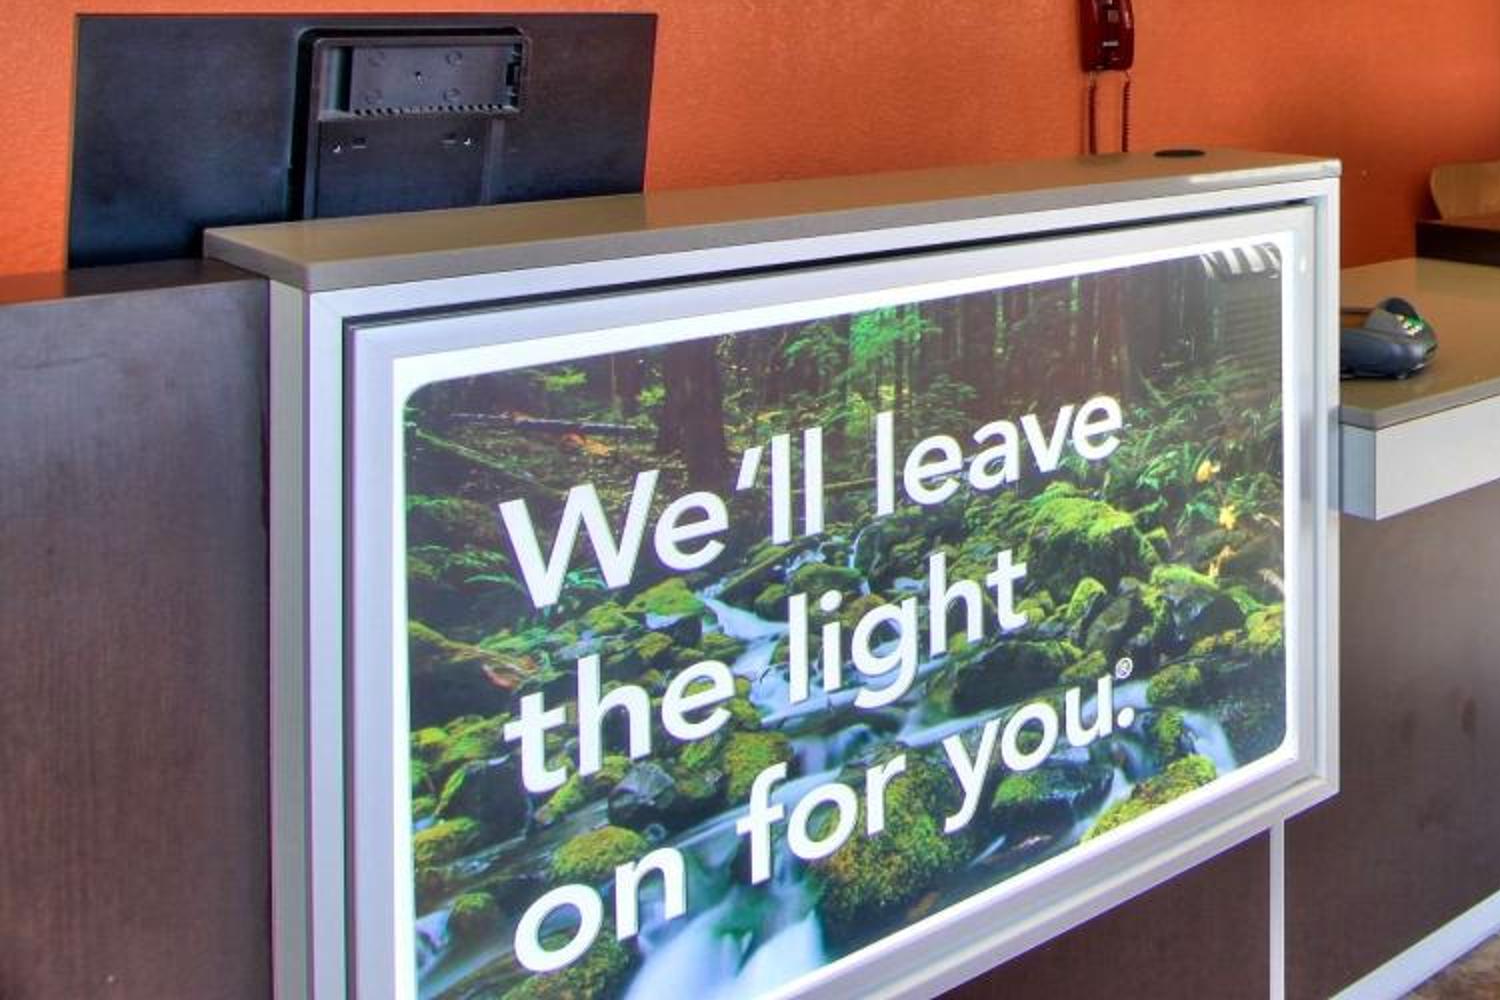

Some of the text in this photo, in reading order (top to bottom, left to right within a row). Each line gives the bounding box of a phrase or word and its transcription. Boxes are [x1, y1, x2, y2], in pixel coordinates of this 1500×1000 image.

[500, 395, 1123, 609] We'll leave
[503, 549, 1029, 796] the light
[513, 845, 689, 974] on
[736, 762, 906, 886] for
